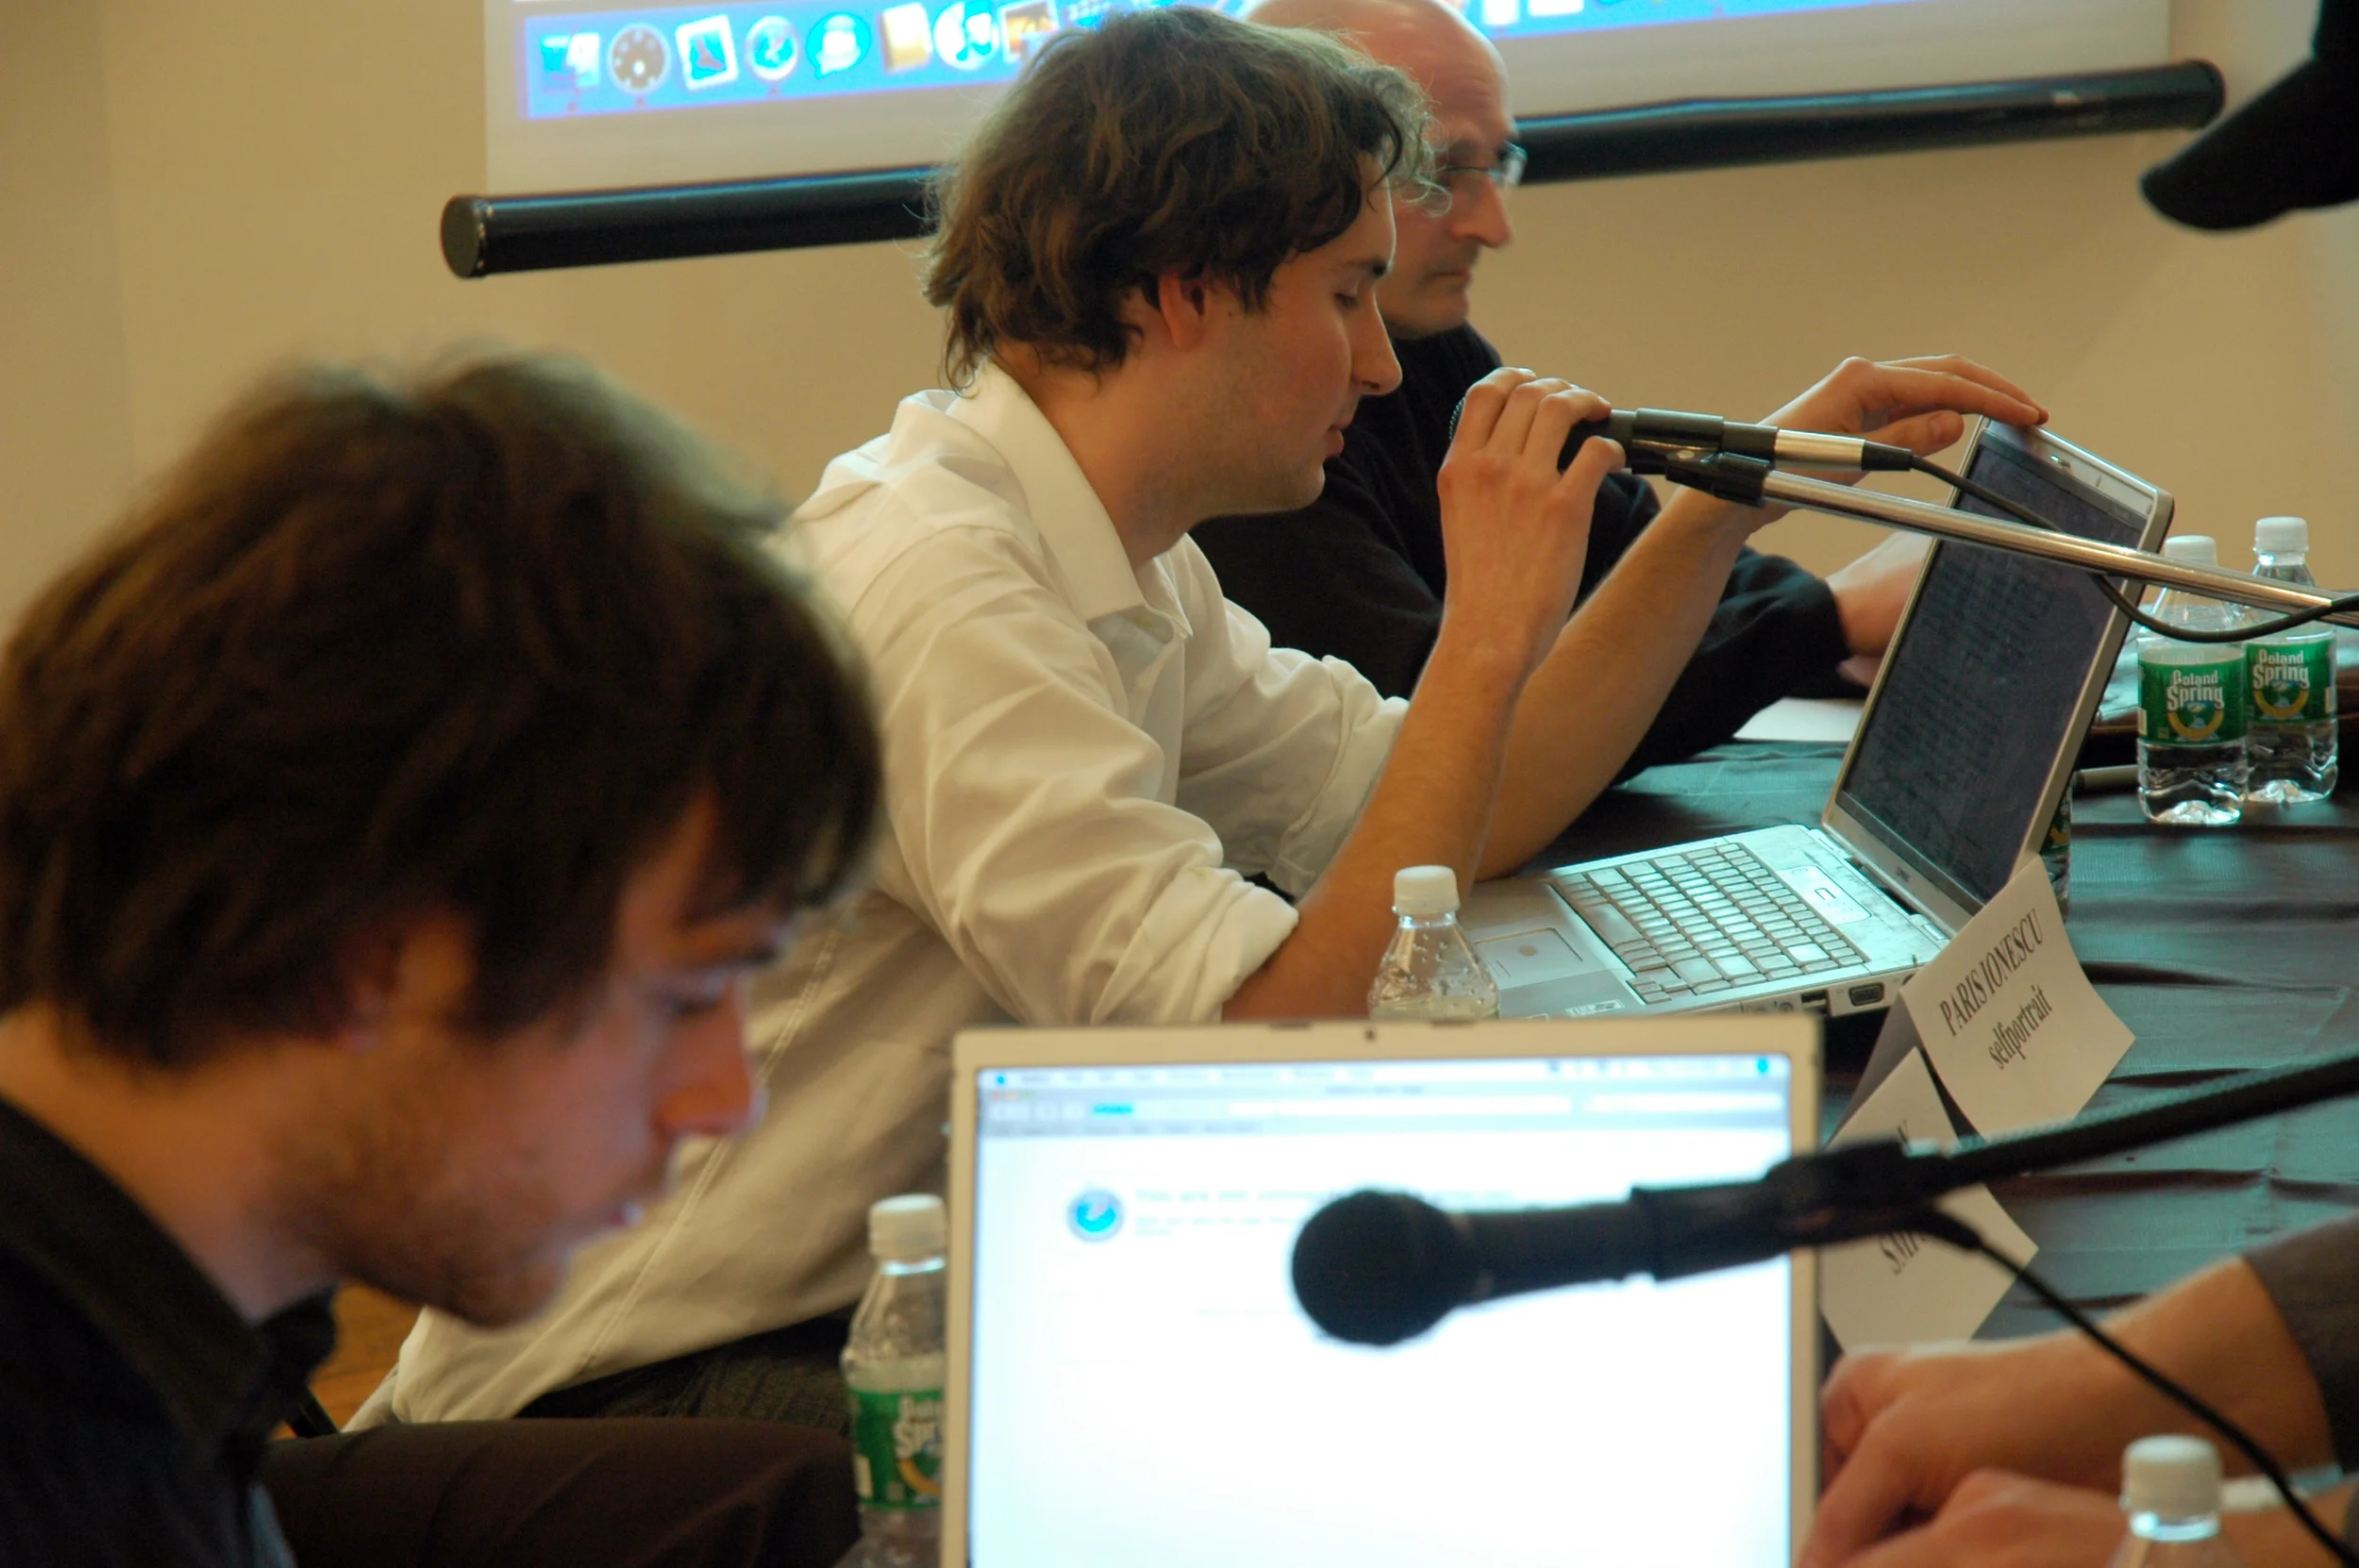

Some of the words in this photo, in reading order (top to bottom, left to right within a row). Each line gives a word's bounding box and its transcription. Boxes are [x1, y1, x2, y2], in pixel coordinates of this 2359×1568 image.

[2258, 648, 2304, 665] Poland
[2172, 669, 2218, 686] Poland
[2252, 664, 2310, 690] Spring
[2167, 686, 2225, 710] Spring
[1939, 969, 1988, 1037] PARIS
[1980, 908, 2044, 995] IONESCU
[1988, 984, 2053, 1070] selfportrait
